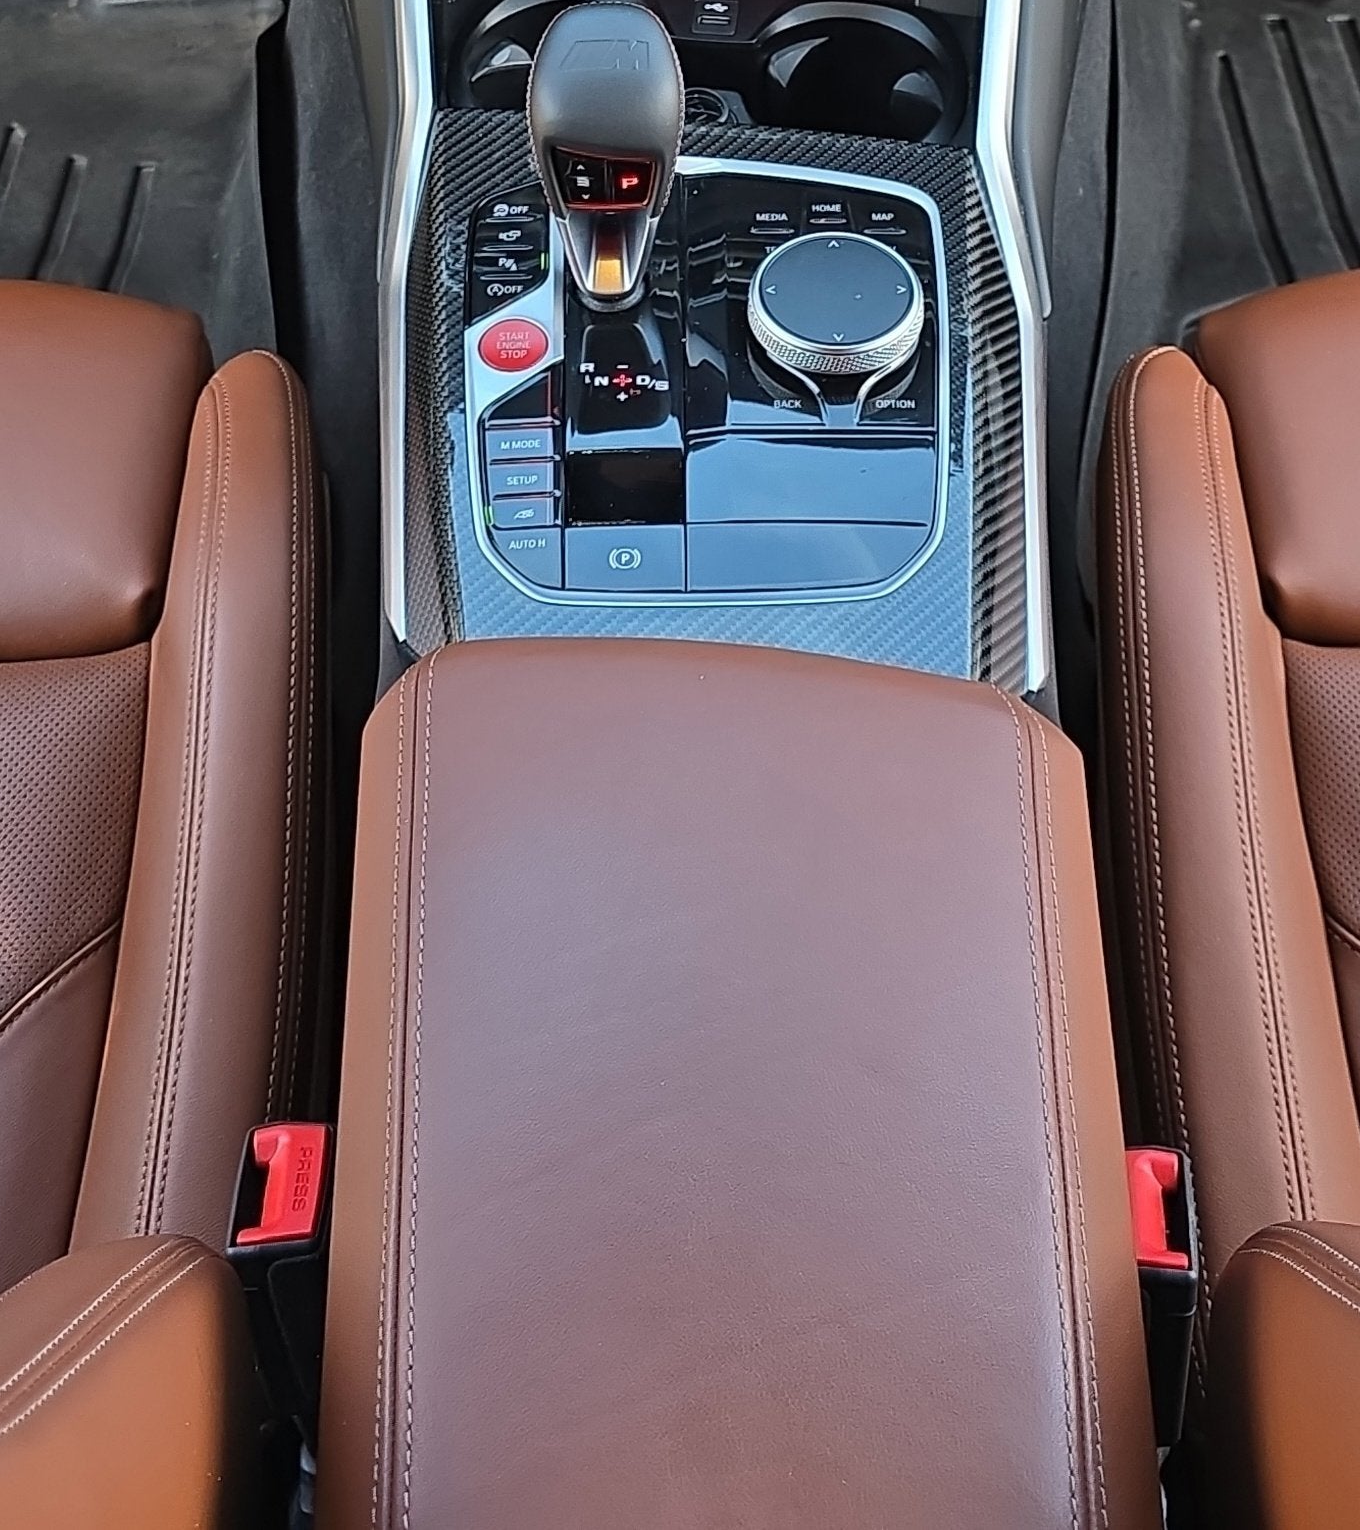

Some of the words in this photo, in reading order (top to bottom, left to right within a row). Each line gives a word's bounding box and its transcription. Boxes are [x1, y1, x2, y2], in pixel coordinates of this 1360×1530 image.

[621, 177, 639, 190] P
[509, 205, 529, 214] OFF
[811, 204, 842, 213] HOME
[755, 213, 788, 221] MEDIA
[871, 213, 895, 221] MAP
[504, 285, 524, 294] OFF
[499, 332, 530, 341] START
[496, 341, 532, 350] ENGINE
[500, 349, 528, 359] STOP
[579, 362, 595, 373] R
[593, 375, 609, 387] N
[773, 399, 803, 409] BACK
[875, 399, 916, 409] OPTION
[501, 441, 510, 450] M
[512, 439, 541, 450] MODE
[506, 475, 538, 486] SETUP
[508, 539, 536, 550] AUTO
[537, 538, 546, 548] H
[291, 1146, 313, 1212] PRESS
